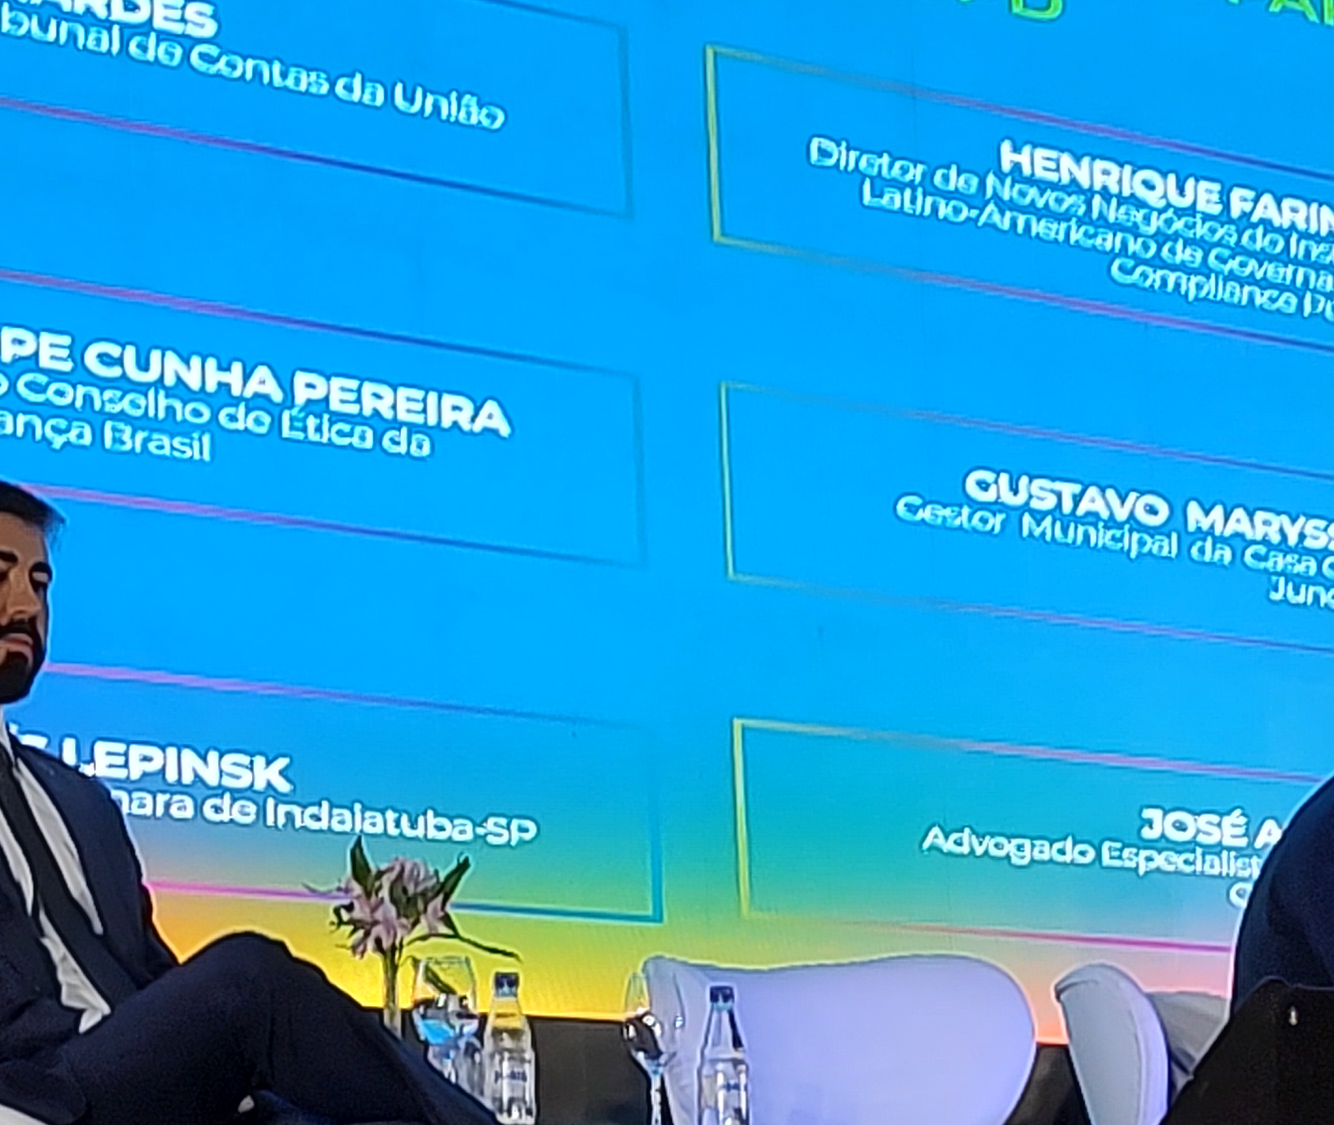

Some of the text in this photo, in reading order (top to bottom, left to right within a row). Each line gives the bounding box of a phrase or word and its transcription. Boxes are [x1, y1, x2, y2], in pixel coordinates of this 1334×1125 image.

[189, 43, 330, 96] Contas
[334, 71, 385, 107] da
[393, 80, 506, 130] União
[809, 137, 926, 185] Diretor
[985, 169, 1086, 216] Novos
[1091, 193, 1238, 248] Negócios
[1241, 224, 1286, 254] do
[1000, 139, 1223, 216] HENRIQUE
[862, 177, 1157, 258] Latino-Americano
[1110, 256, 1298, 314] Compliance
[16, 371, 212, 424] Conselho
[280, 405, 374, 451] Ética
[83, 341, 284, 405] CUNHA
[292, 369, 513, 439] PEREIRA
[103, 419, 212, 463] Brasil
[964, 469, 1170, 527] GUSTAVO
[895, 495, 1007, 535] Gestor
[1021, 512, 1179, 560] Municipal
[1190, 535, 1232, 566] da
[1243, 544, 1317, 577] Casa
[62, 736, 293, 794] LEPINSK
[202, 791, 256, 825] de
[266, 796, 538, 848] Indaiatuba-SP
[922, 824, 1262, 879] Advogado Especialist
[1140, 806, 1250, 848] JOSÉ
